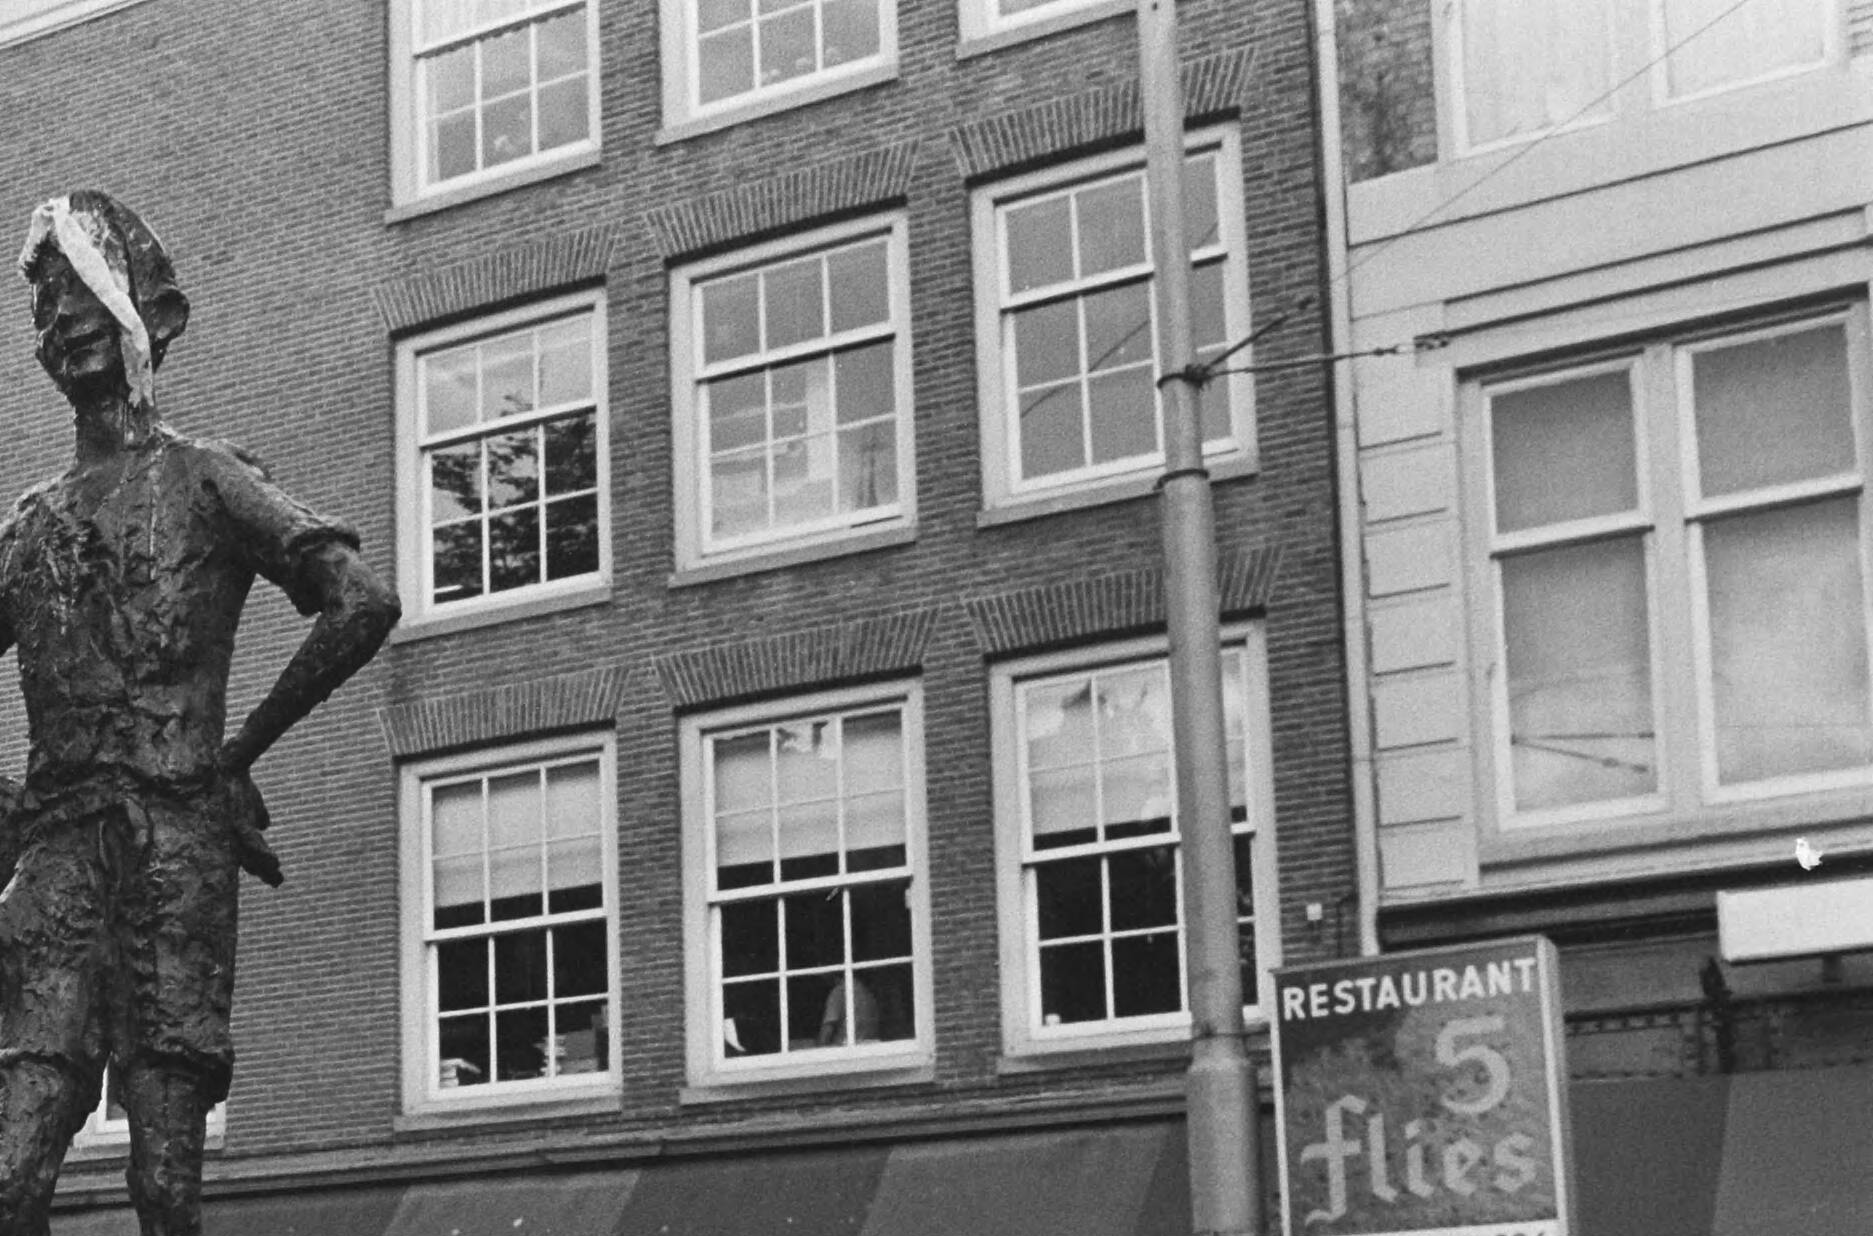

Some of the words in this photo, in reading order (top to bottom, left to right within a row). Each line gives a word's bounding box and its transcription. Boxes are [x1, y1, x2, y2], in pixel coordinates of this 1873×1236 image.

[1283, 956, 1537, 1021] RESTAURANT
[1434, 1014, 1510, 1114] 5
[1299, 1094, 1538, 1227] flies
